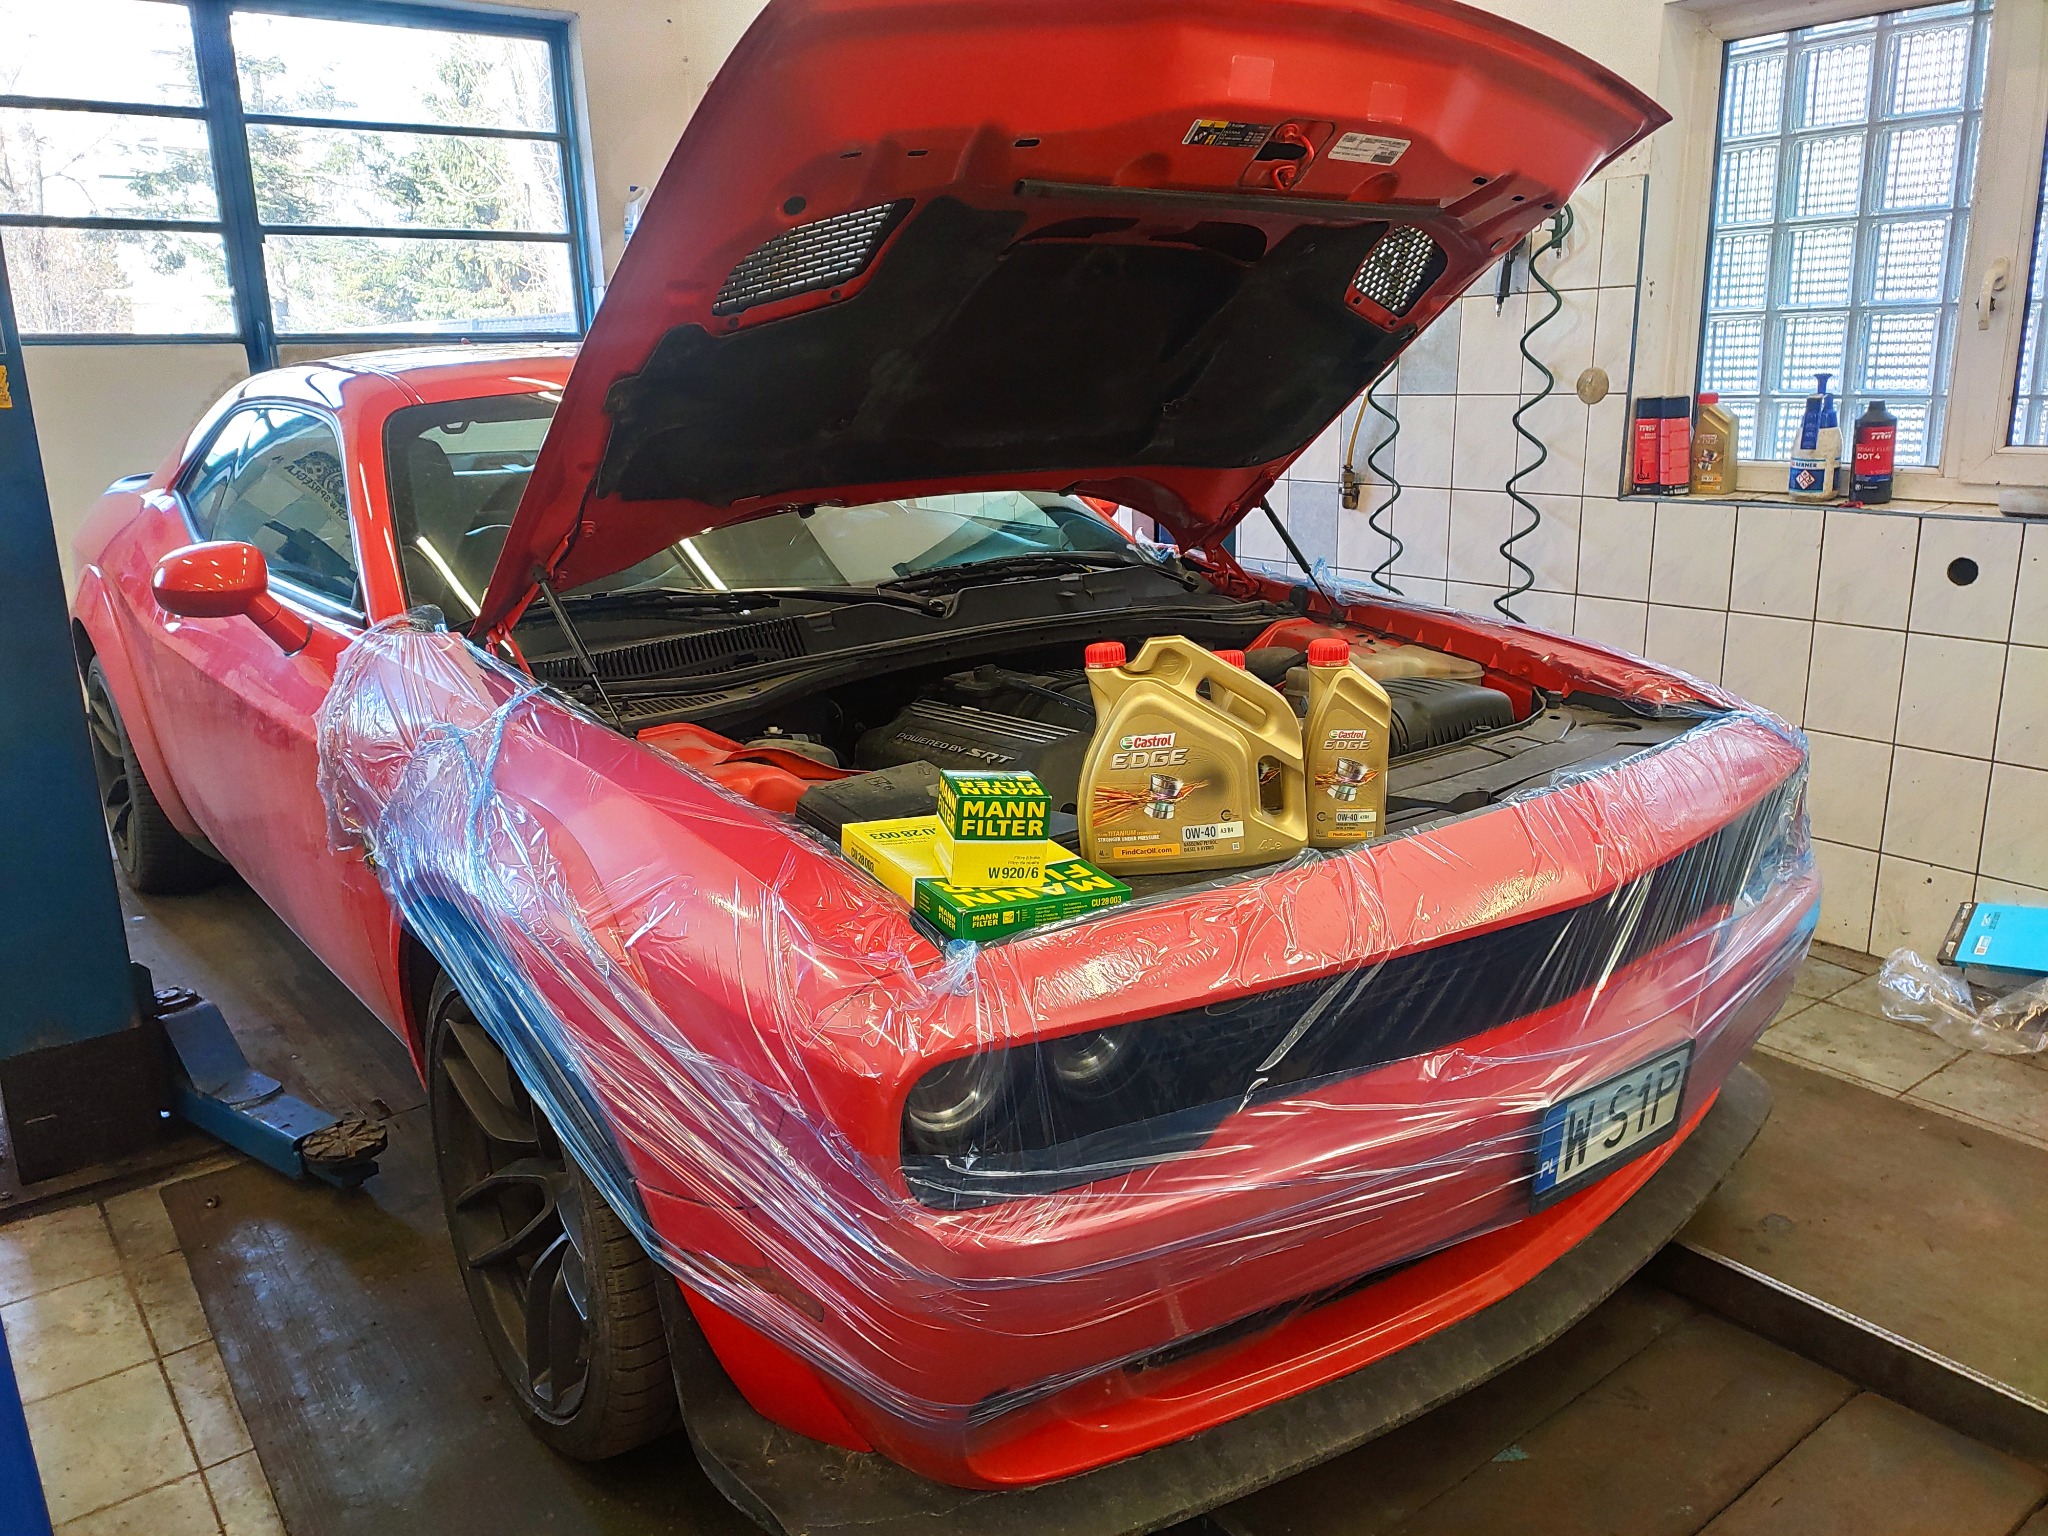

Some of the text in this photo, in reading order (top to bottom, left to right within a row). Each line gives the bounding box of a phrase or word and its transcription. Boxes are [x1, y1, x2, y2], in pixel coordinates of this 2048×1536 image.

[1871, 431, 1893, 439] TRW
[1338, 730, 1364, 739] Castrol
[896, 732, 1016, 764] POWERED BY SRT
[1133, 735, 1172, 748] Castrol
[1322, 740, 1372, 751] EDGE
[1111, 748, 1189, 770] EDGE
[940, 775, 957, 815] MANN
[960, 788, 1044, 796] MANN
[963, 800, 1046, 818] MANN
[1337, 813, 1358, 822] 0W-40
[900, 829, 922, 837] 28
[961, 819, 1044, 837] FILTER
[1108, 829, 1137, 837] TITANIUM
[1185, 826, 1216, 840] 0W-40
[869, 831, 900, 840] 003
[1121, 847, 1173, 856] FindCarOil.com
[988, 866, 1039, 879] W 920/6
[952, 876, 1116, 908] MANN
[1091, 898, 1101, 908] CU
[1110, 895, 1122, 905] 003
[938, 905, 956, 923] MANN
[972, 912, 999, 921] MANN
[938, 913, 956, 932] FILTER
[972, 919, 999, 929] FILTER
[1563, 1100, 1596, 1173] W
[1539, 1161, 1556, 1179] PL
